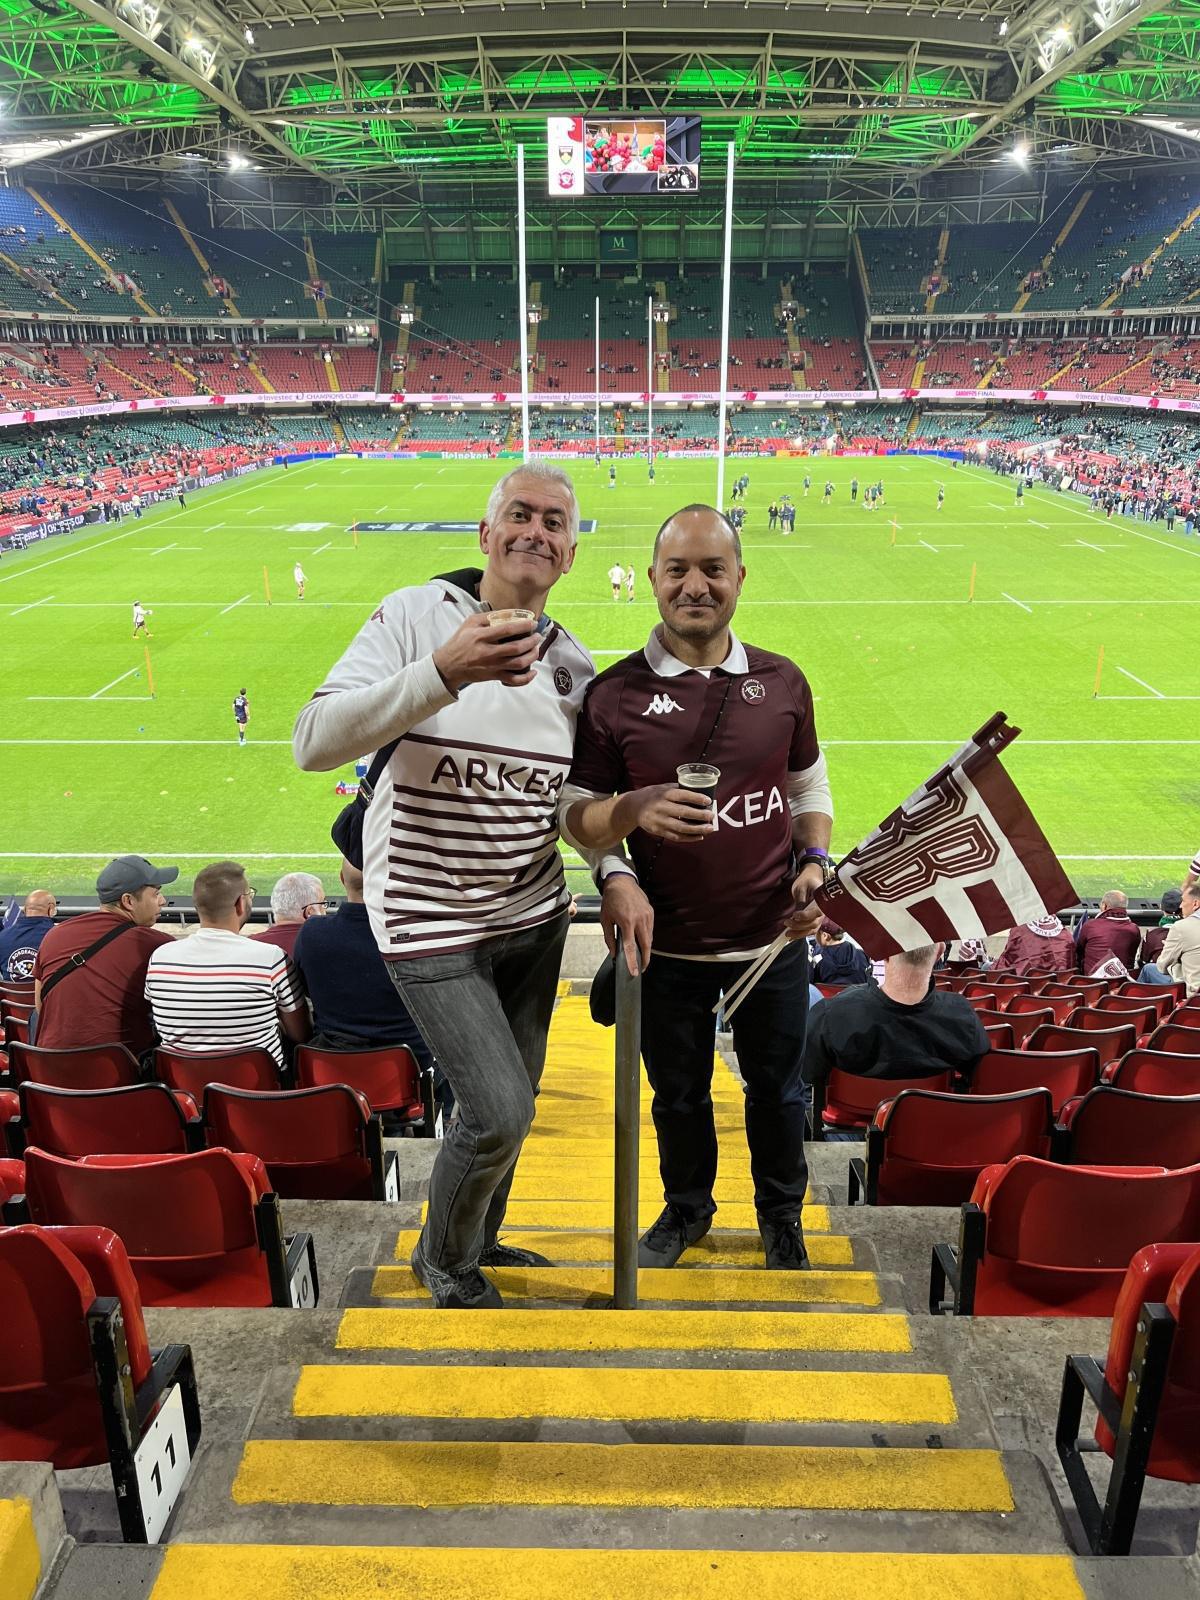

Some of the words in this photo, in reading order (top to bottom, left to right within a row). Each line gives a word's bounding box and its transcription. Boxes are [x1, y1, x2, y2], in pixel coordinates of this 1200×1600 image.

[613, 237, 625, 248] M
[441, 451, 489, 459] Heineken
[430, 754, 564, 796] ARKEA
[711, 785, 784, 832] KEA
[150, 1432, 176, 1497] 11
